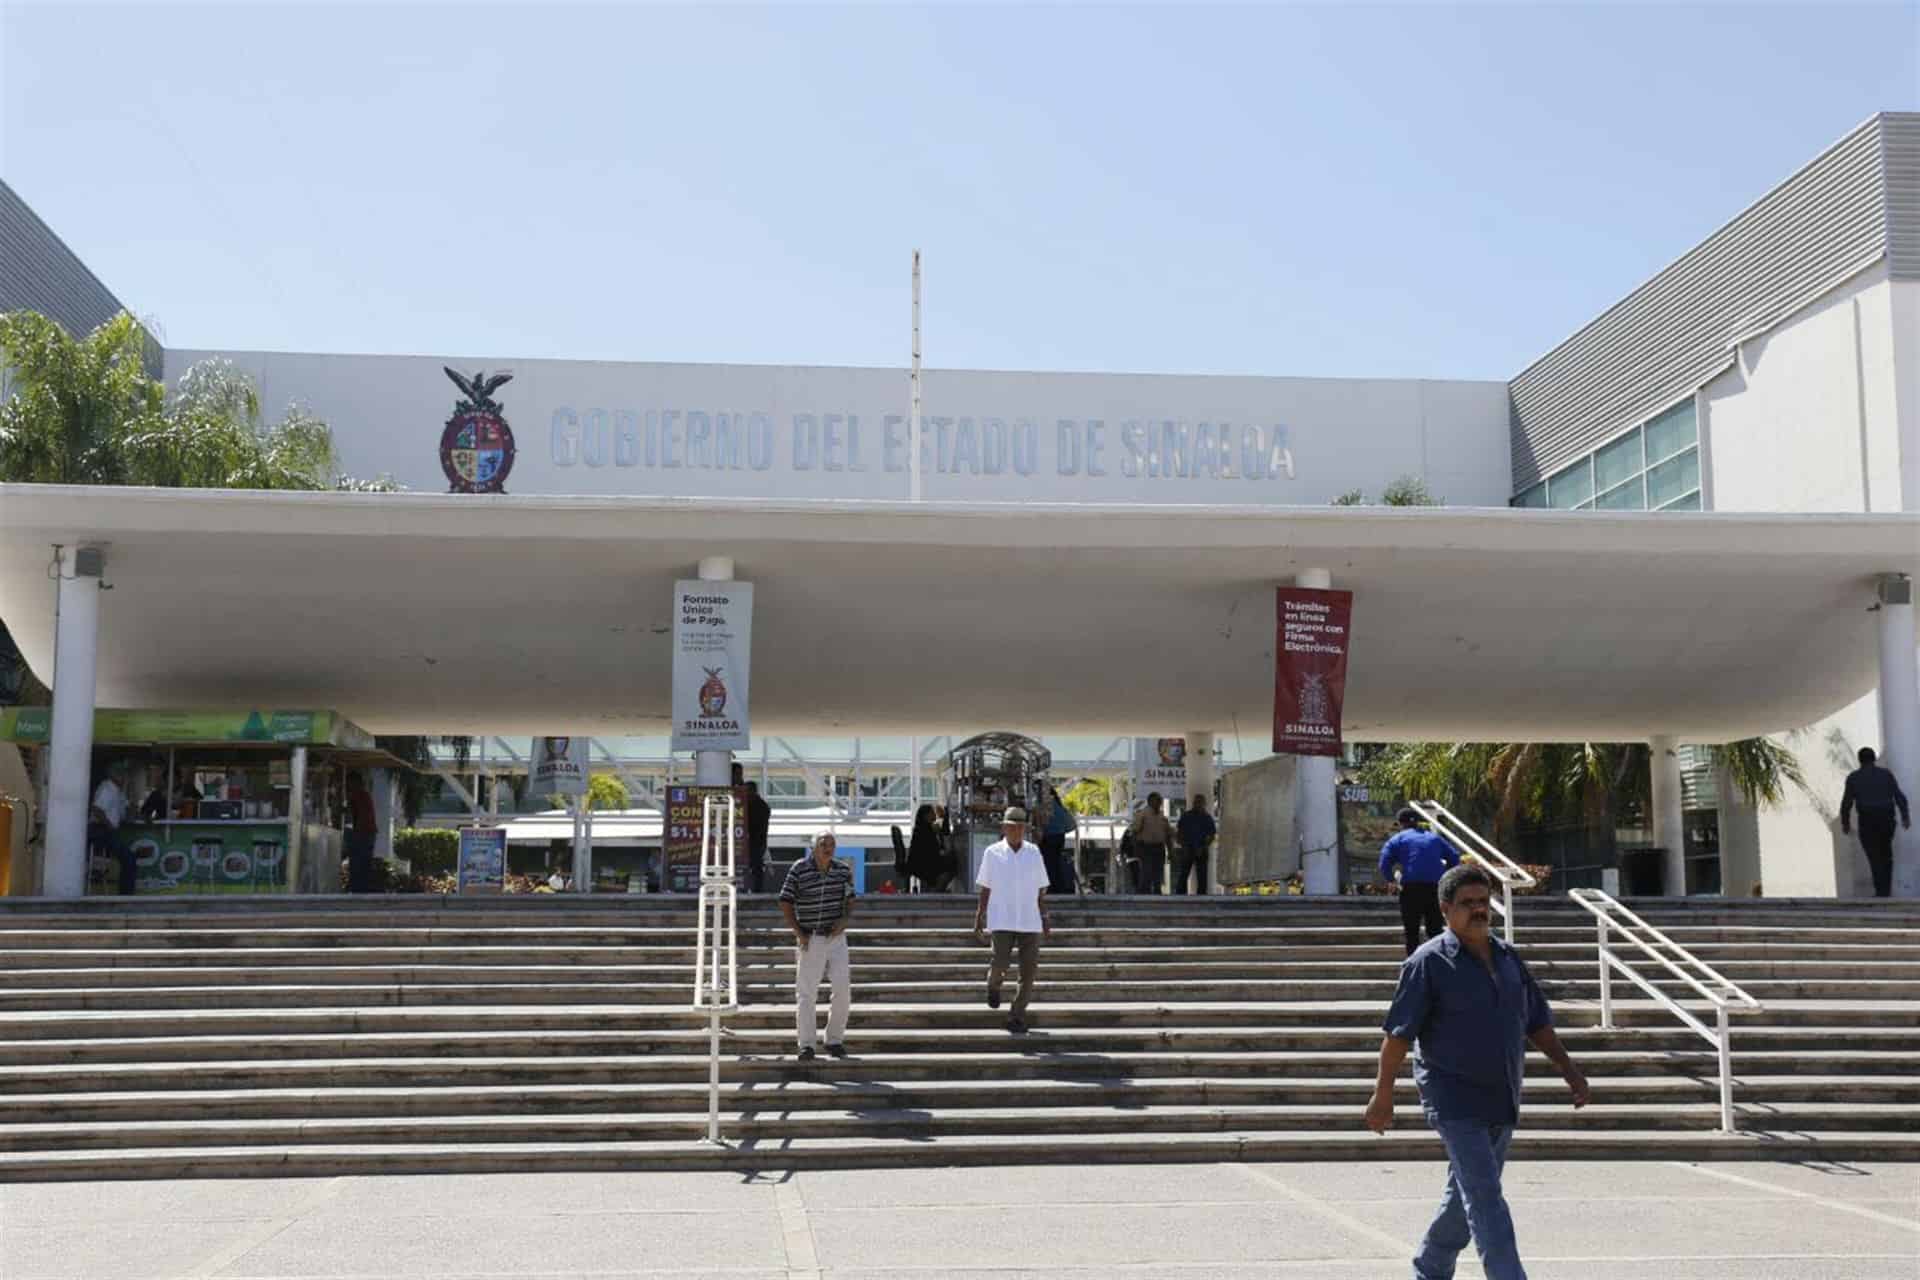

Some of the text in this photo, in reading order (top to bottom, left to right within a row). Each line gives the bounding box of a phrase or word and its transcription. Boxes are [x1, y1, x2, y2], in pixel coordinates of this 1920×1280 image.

[551, 407, 1297, 481] GOBIERNO DEL ESTADO DE SINALOA
[683, 595, 729, 604] Formato
[683, 616, 697, 624] de
[1285, 613, 1298, 621] en
[1285, 623, 1344, 633] seguros con
[1285, 632, 1315, 641] Firma
[686, 720, 739, 729] SINALOA
[1285, 724, 1335, 735] SINALOA
[1144, 769, 1187, 778] SINAL
[1342, 787, 1397, 801] SUBWAY
